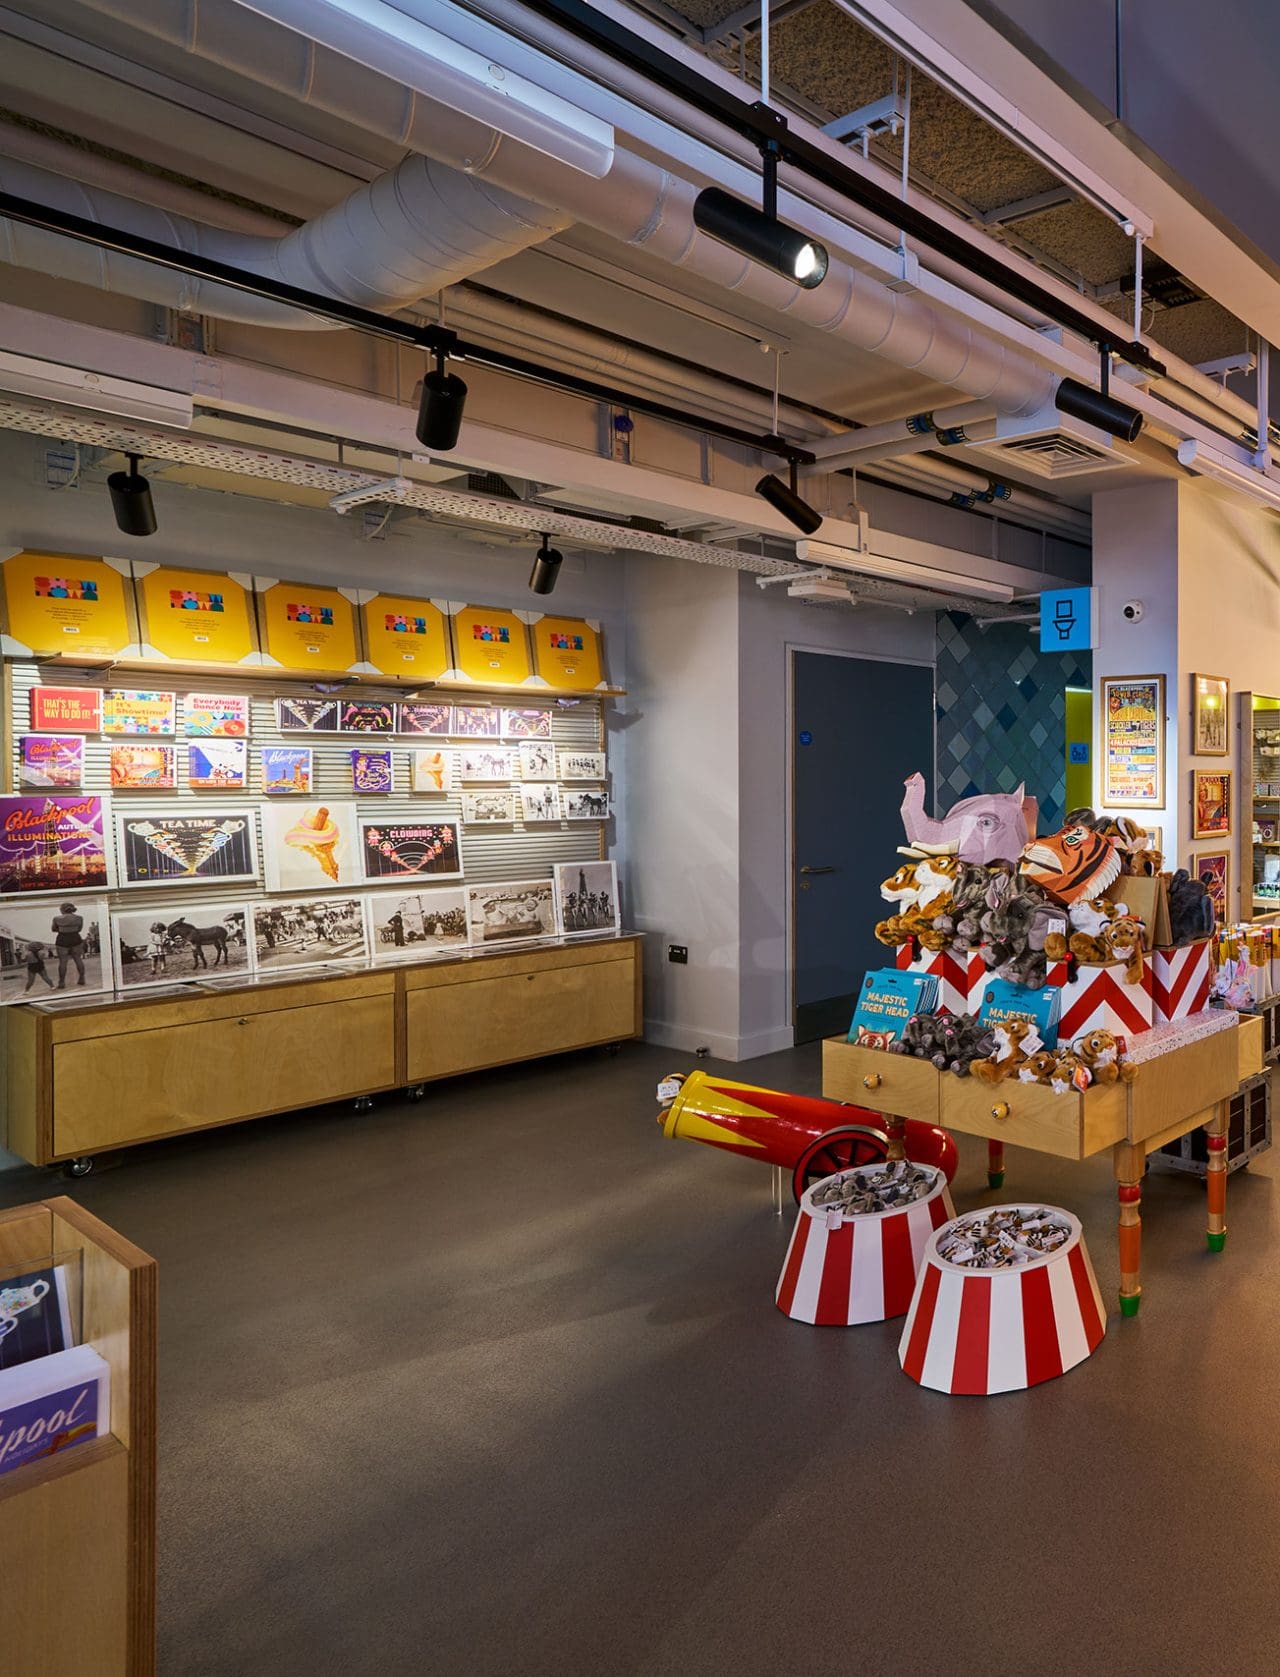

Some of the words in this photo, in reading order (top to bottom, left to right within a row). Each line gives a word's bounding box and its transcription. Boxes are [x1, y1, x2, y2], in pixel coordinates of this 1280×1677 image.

[43, 697, 66, 709] THAT'S
[67, 699, 81, 709] THE
[193, 698, 241, 707] Everybody
[43, 708, 59, 718] WAY
[61, 709, 69, 719] TO
[70, 709, 80, 719] DO
[115, 708, 168, 716] Showtime!
[4, 797, 96, 832] Blackpool
[160, 820, 183, 829] TEA
[186, 819, 217, 829] TIME
[7, 831, 93, 842] ILLUMINATIONS
[390, 829, 433, 838] CLOWNING
[867, 991, 908, 1007] MAJESTIC
[861, 1001, 883, 1014] TIGER
[885, 1005, 909, 1018] HEAD
[988, 1007, 1038, 1024] MAJESTIC
[0, 1389, 88, 1463] pool
